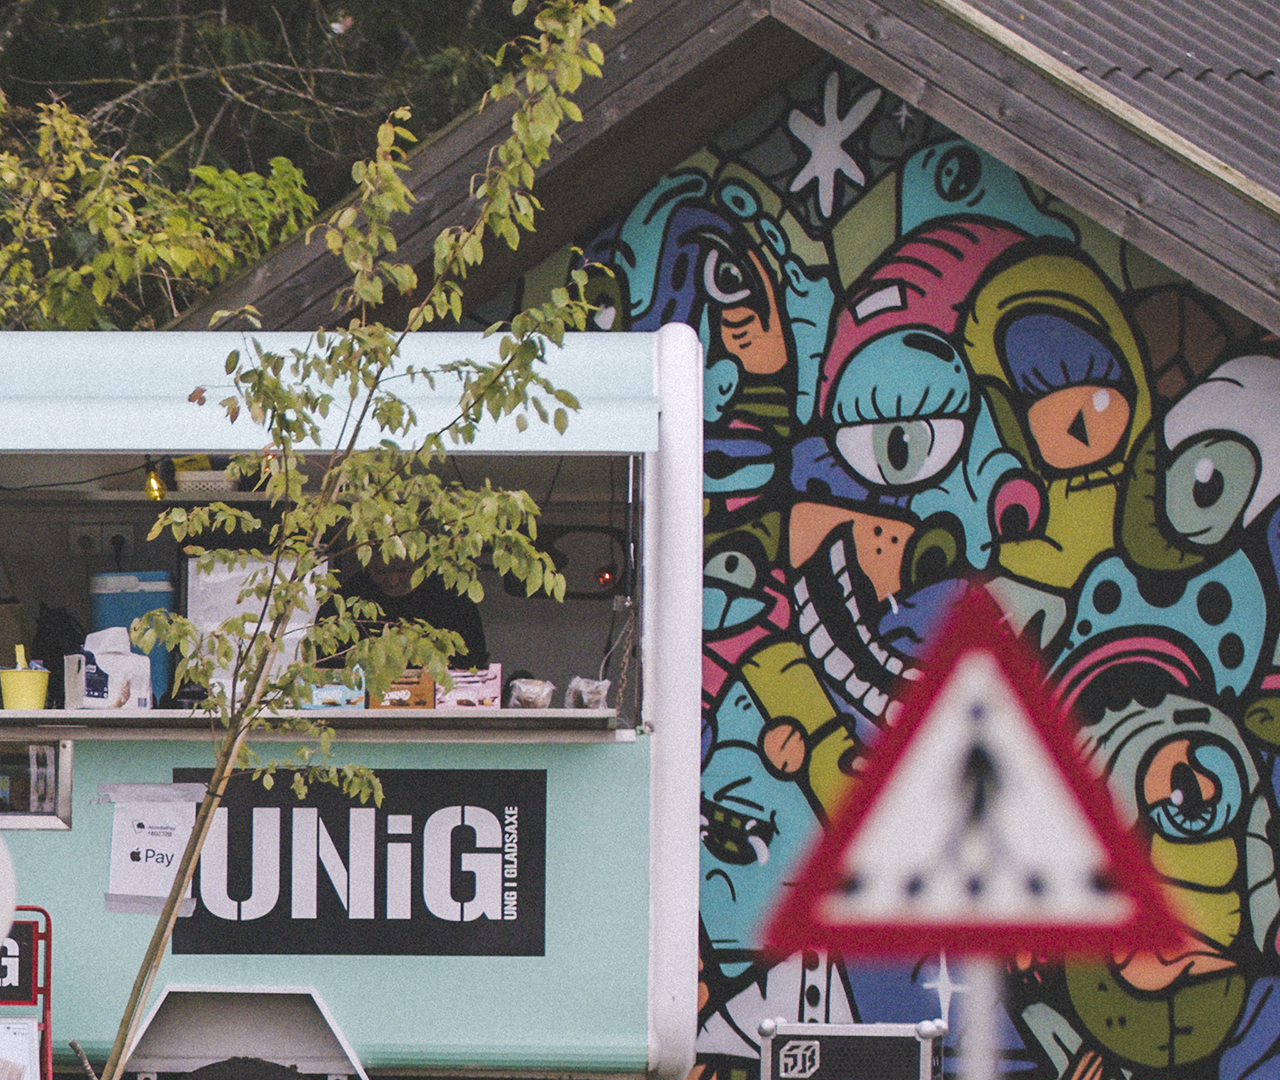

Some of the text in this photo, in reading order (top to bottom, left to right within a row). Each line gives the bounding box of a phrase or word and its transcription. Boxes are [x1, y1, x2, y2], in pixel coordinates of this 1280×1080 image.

[504, 806, 518, 878] GLADSAXE
[145, 849, 175, 868] Pay
[504, 891, 517, 921] UNG
